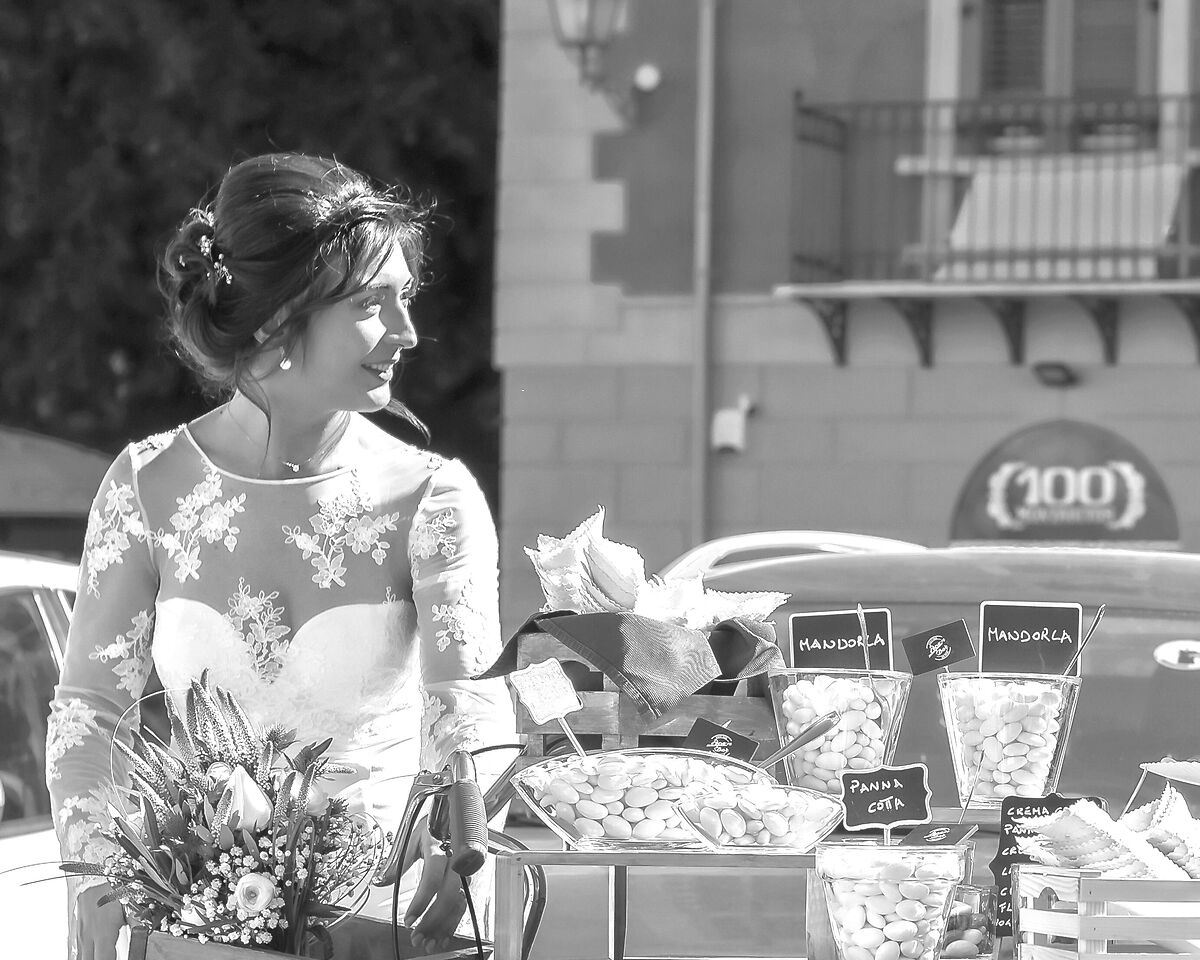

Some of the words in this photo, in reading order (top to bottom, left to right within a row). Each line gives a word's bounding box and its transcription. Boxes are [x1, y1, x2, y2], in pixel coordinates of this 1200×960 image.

[1016, 465, 1116, 505] 100
[987, 626, 1073, 645] MANDORLA
[850, 778, 904, 794] PANNA
[867, 796, 905, 814] COTTA
